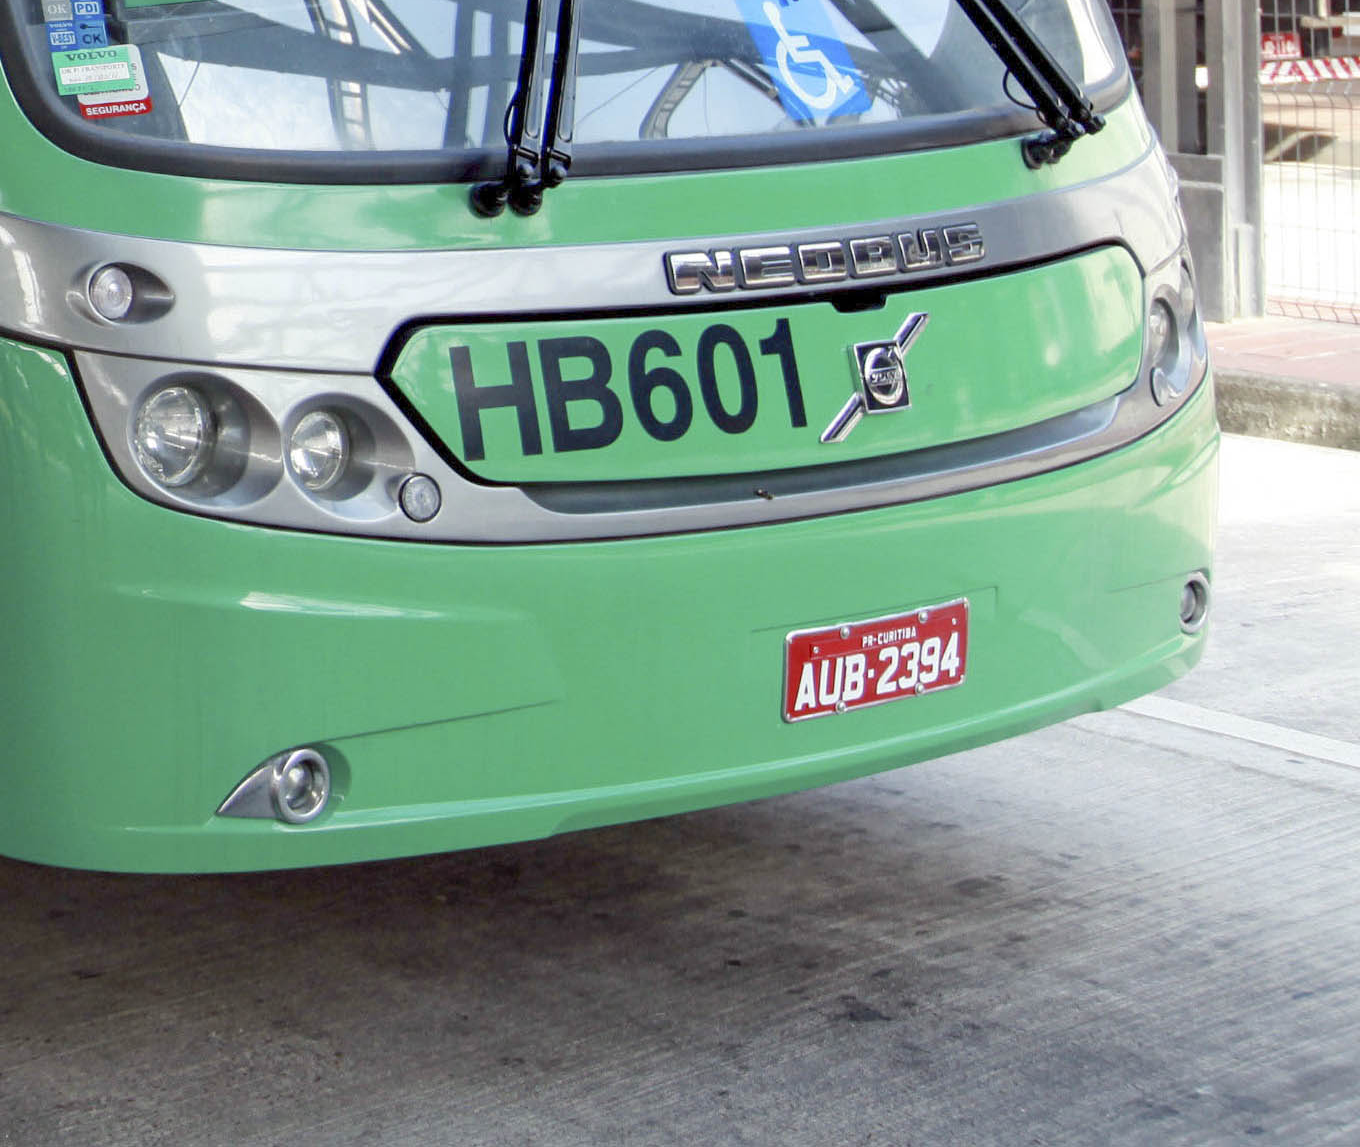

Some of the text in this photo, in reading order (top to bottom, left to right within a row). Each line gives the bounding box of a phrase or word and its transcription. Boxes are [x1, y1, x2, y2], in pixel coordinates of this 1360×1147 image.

[48, 3, 67, 14] OK
[76, 3, 98, 13] PDI
[82, 33, 103, 44] OK
[64, 50, 117, 61] VOLVO
[86, 102, 146, 116] SEGURANÇA
[665, 222, 985, 295] NEOBUS
[447, 317, 808, 461] HB601
